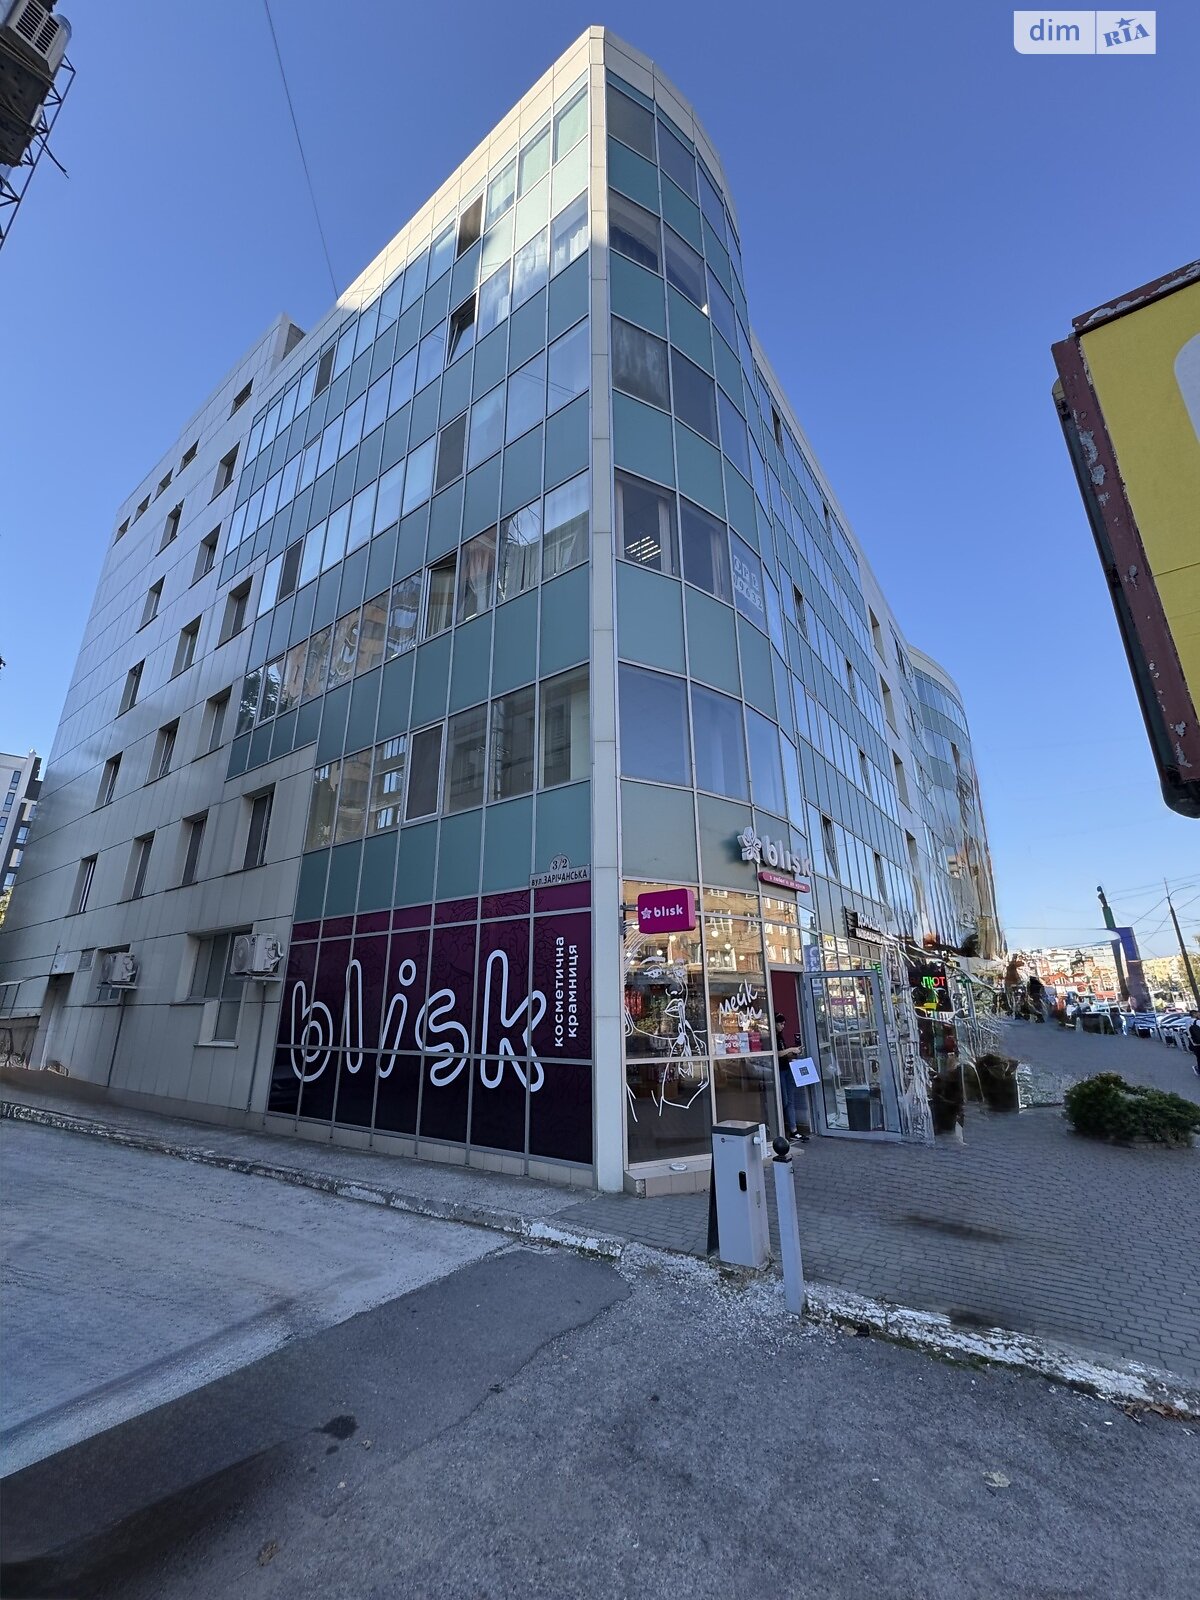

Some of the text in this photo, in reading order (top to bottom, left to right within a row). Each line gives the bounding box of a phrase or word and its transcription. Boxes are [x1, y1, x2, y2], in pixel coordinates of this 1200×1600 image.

[552, 858, 568, 871] 3/2
[760, 834, 813, 878] blisk
[653, 904, 684, 918] blisk
[290, 949, 547, 1092] blisk
[553, 936, 565, 1047] косметична
[567, 944, 579, 1038] крамниця
